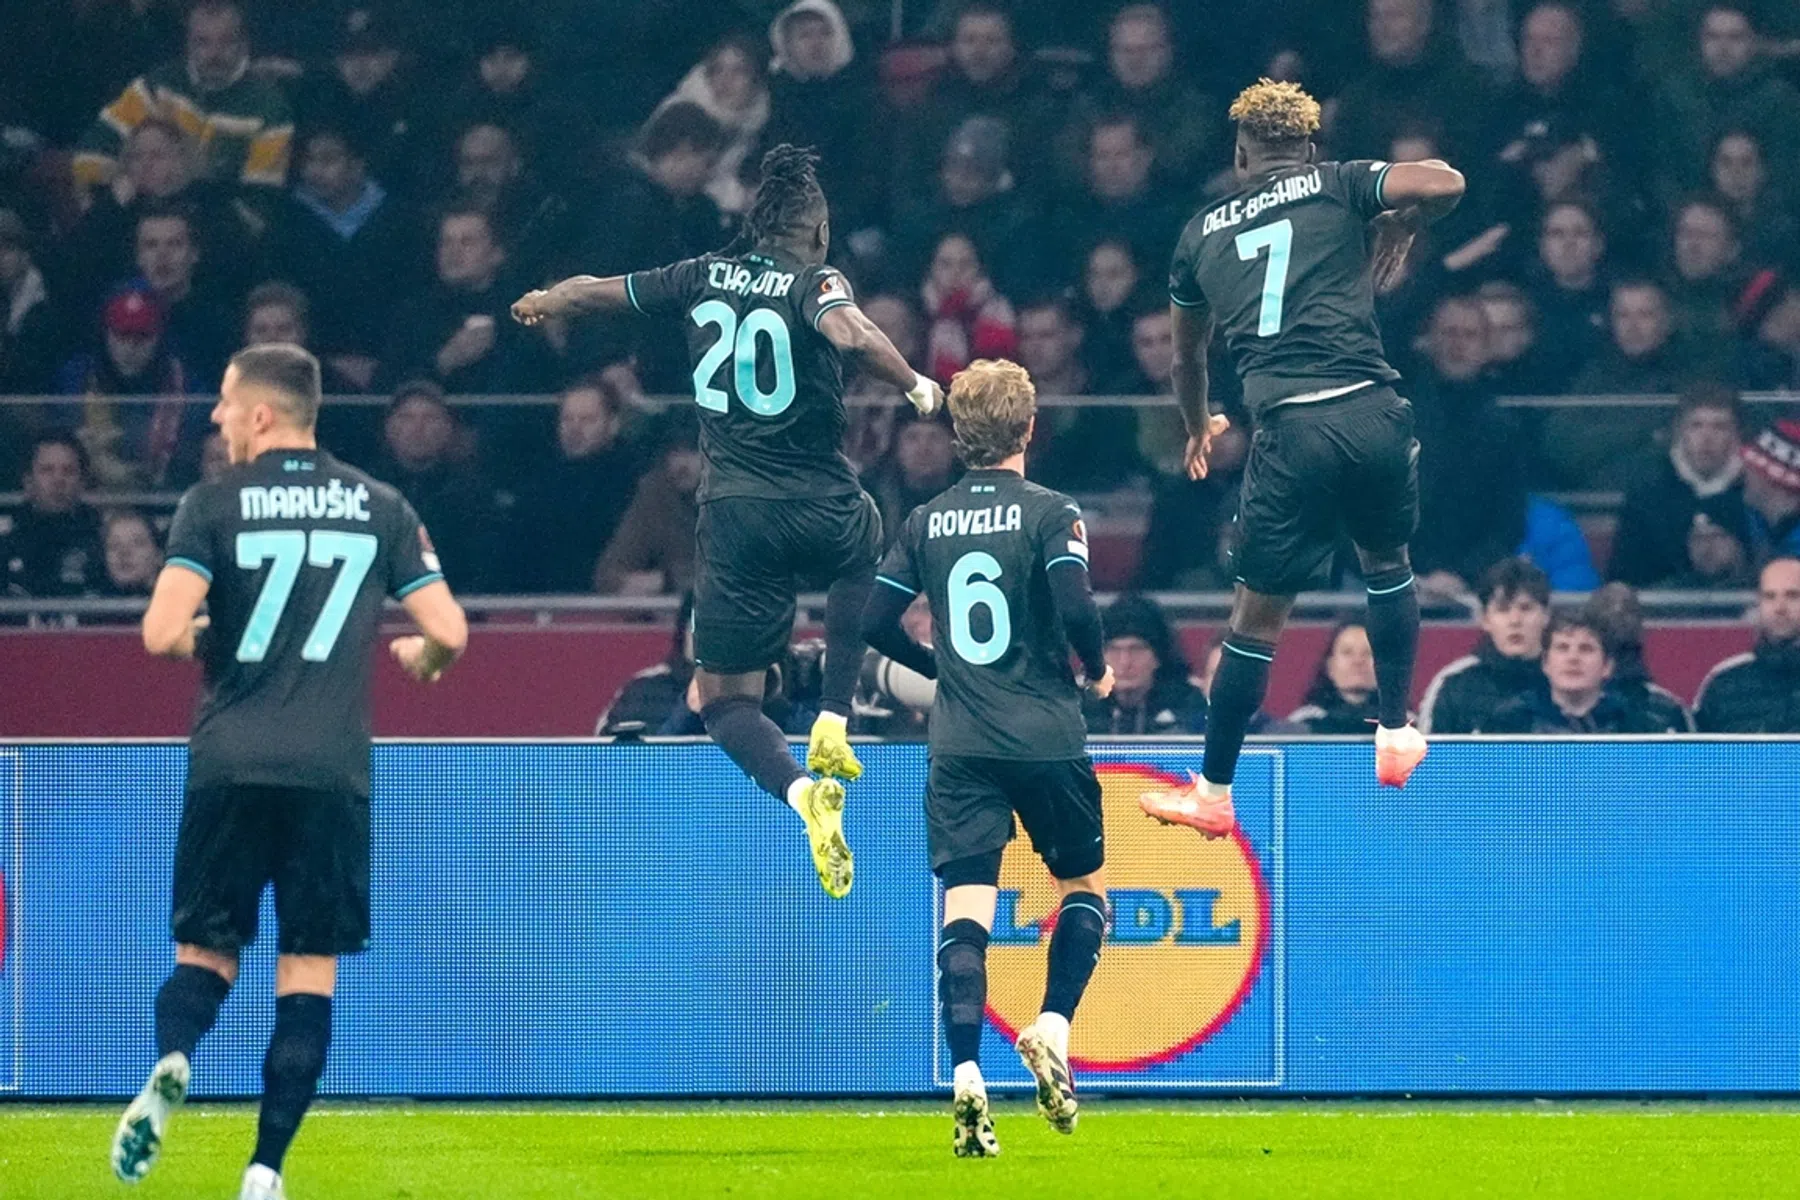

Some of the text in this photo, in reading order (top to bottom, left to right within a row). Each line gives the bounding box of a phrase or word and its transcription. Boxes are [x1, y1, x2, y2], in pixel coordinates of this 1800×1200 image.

[1235, 218, 1293, 337] 7
[690, 300, 796, 416] 20
[239, 478, 371, 521] MARUŠIĆ
[928, 504, 1022, 539] ROVELLA
[236, 529, 378, 663] 77
[947, 551, 1011, 665] 6
[988, 888, 1241, 946] LDL
